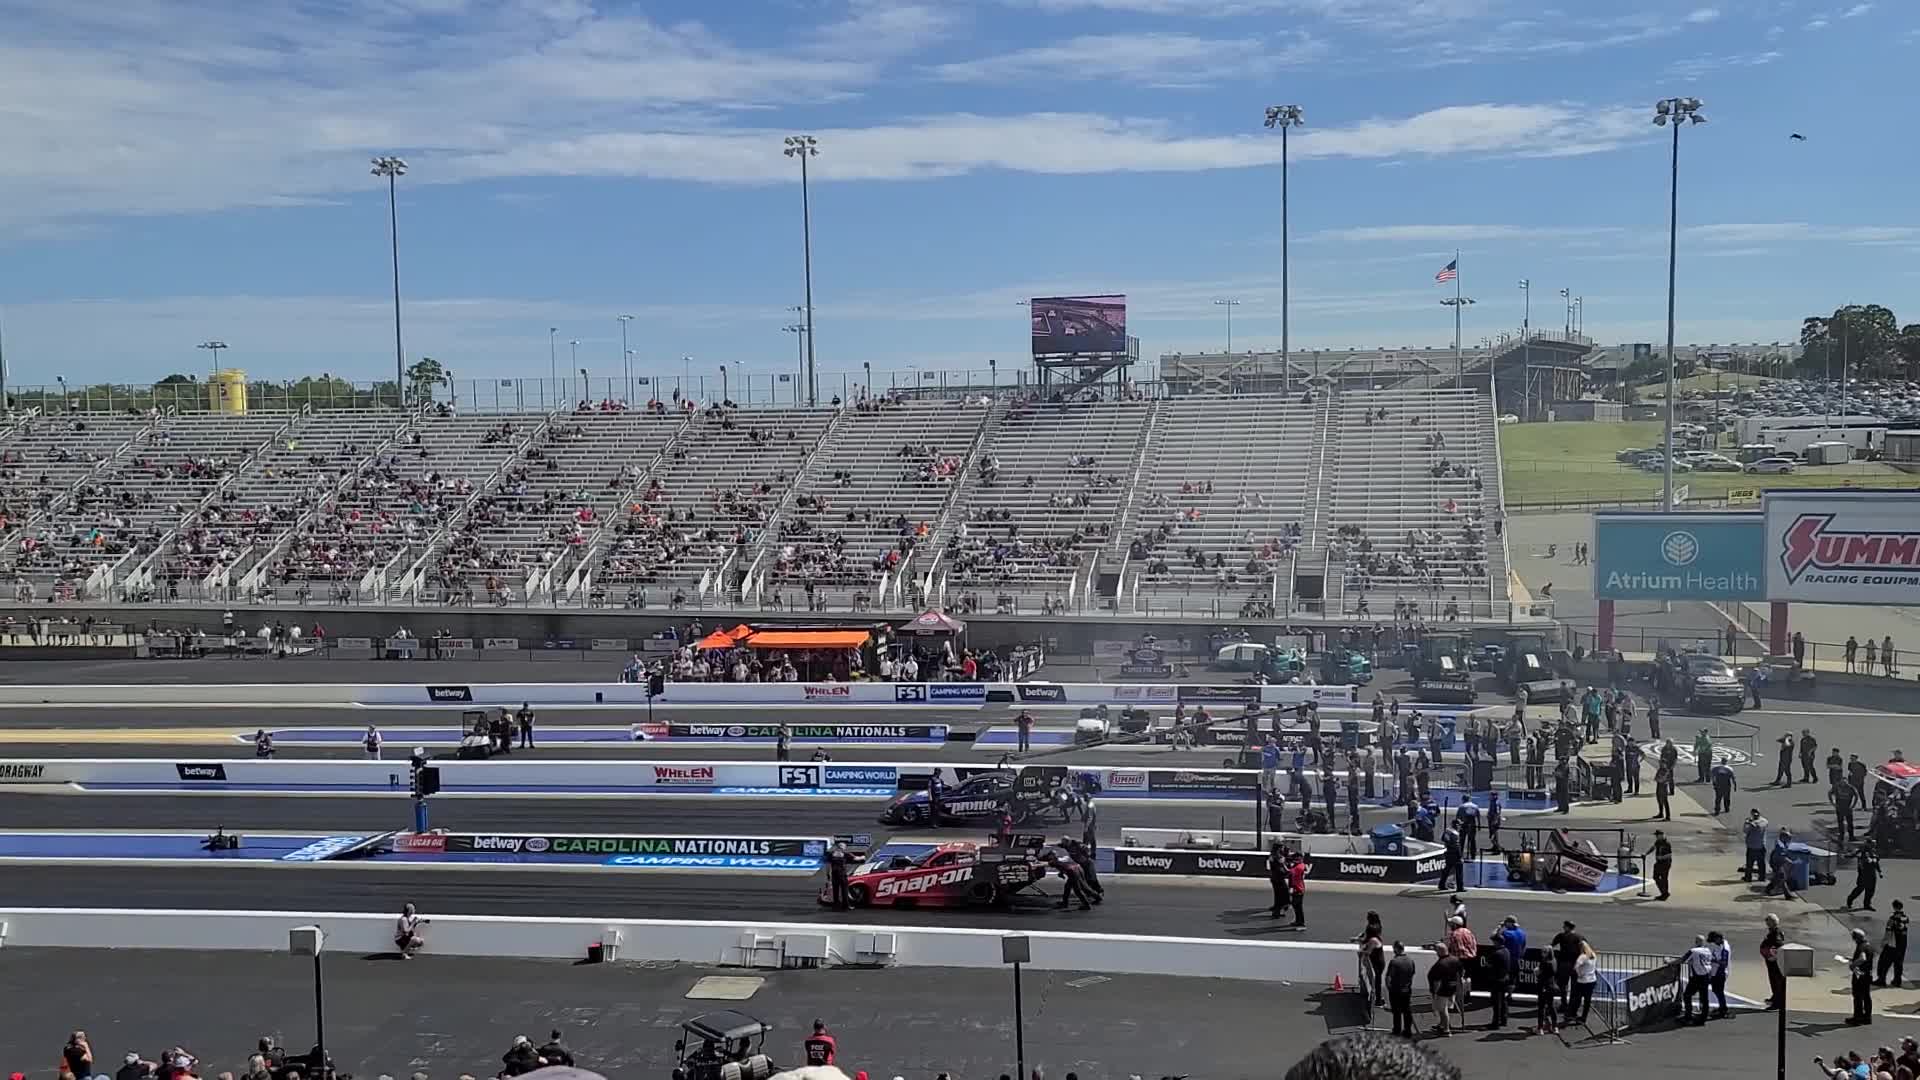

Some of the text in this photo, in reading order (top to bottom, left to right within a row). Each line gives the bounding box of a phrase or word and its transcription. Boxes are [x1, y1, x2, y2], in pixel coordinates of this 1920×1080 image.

[1731, 490, 1753, 498] JEGS
[1606, 570, 1757, 591] Atrium Health
[1805, 574, 1919, 586] RACING EQUIPM
[434, 689, 465, 699] betway
[804, 685, 849, 696] WHELEN
[896, 686, 923, 698] FS1
[931, 688, 960, 696] CAMPING
[1025, 688, 1058, 698] betway
[690, 725, 726, 737] betway
[748, 727, 833, 736] CARLINA
[836, 727, 906, 736] NATIONALS
[185, 766, 216, 777] betway
[654, 766, 714, 778] WHELEN
[780, 768, 818, 784] FS1
[825, 769, 895, 780] CAMPING WORLD
[946, 800, 998, 815] pronto
[474, 836, 524, 852] betway
[553, 838, 671, 852] CAROLINA
[674, 839, 770, 854] NATIONALS
[614, 855, 819, 868] CAMPING WORLD
[1127, 855, 1173, 870] betway
[1198, 857, 1245, 872] betway
[1416, 857, 1446, 874] betwa
[1340, 862, 1388, 878] betway
[875, 867, 973, 898] Snap-on
[1519, 959, 1540, 970] DRIV
[1628, 979, 1680, 1012] betway
